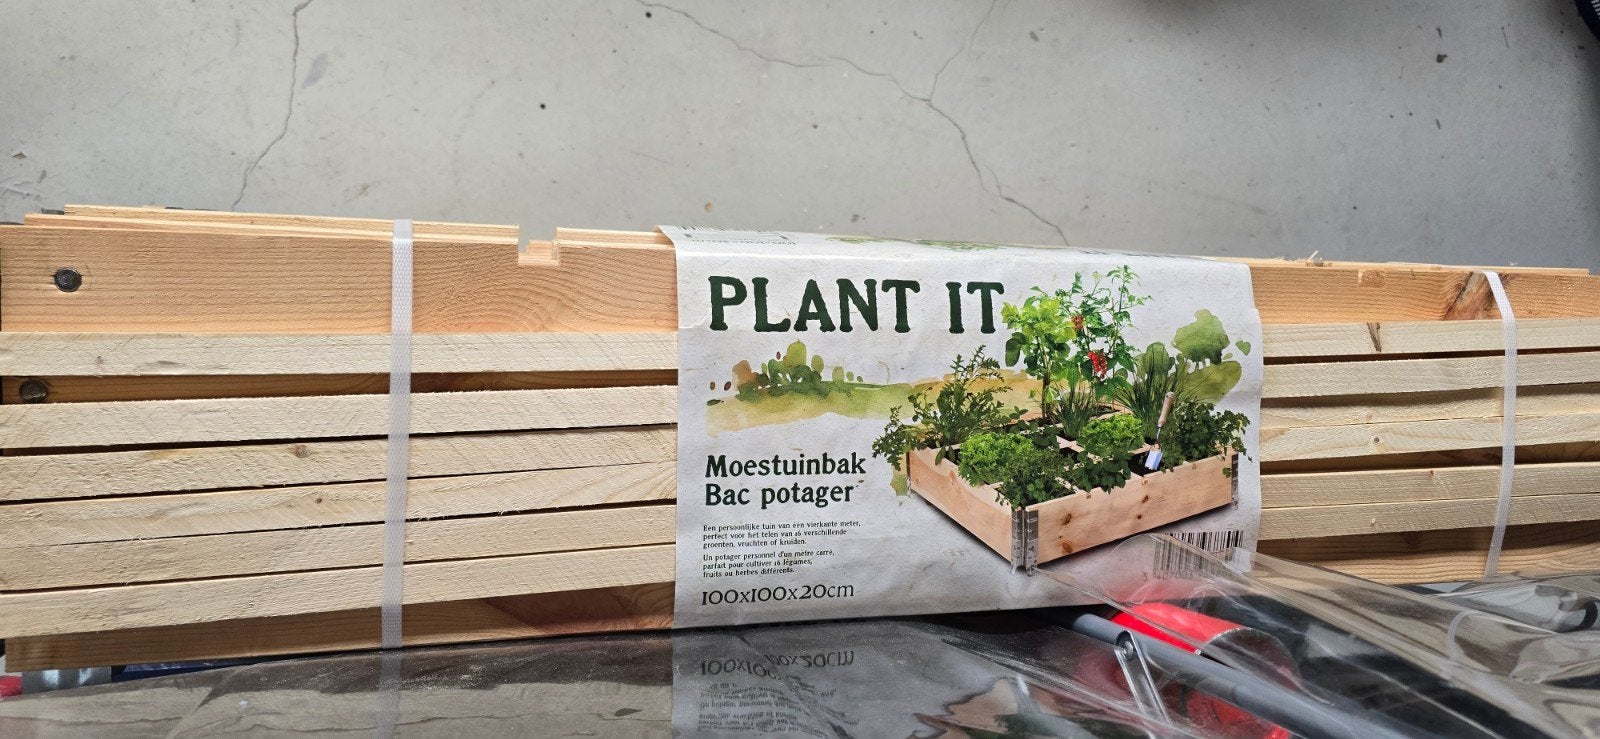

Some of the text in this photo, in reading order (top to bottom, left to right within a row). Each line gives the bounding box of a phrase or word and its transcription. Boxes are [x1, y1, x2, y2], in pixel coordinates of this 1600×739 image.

[707, 275, 1005, 334] PLANT IT
[705, 452, 866, 478] Moestuinbak
[705, 482, 854, 509] Bac potager
[718, 523, 760, 532] persoonlijke
[703, 533, 728, 541] perfect
[779, 538, 807, 546] kruiden.
[715, 554, 741, 562] potager
[743, 552, 776, 561] personnel
[703, 562, 727, 570] parfait
[703, 570, 722, 578] fruits
[702, 584, 854, 605] 100x100x20cm
